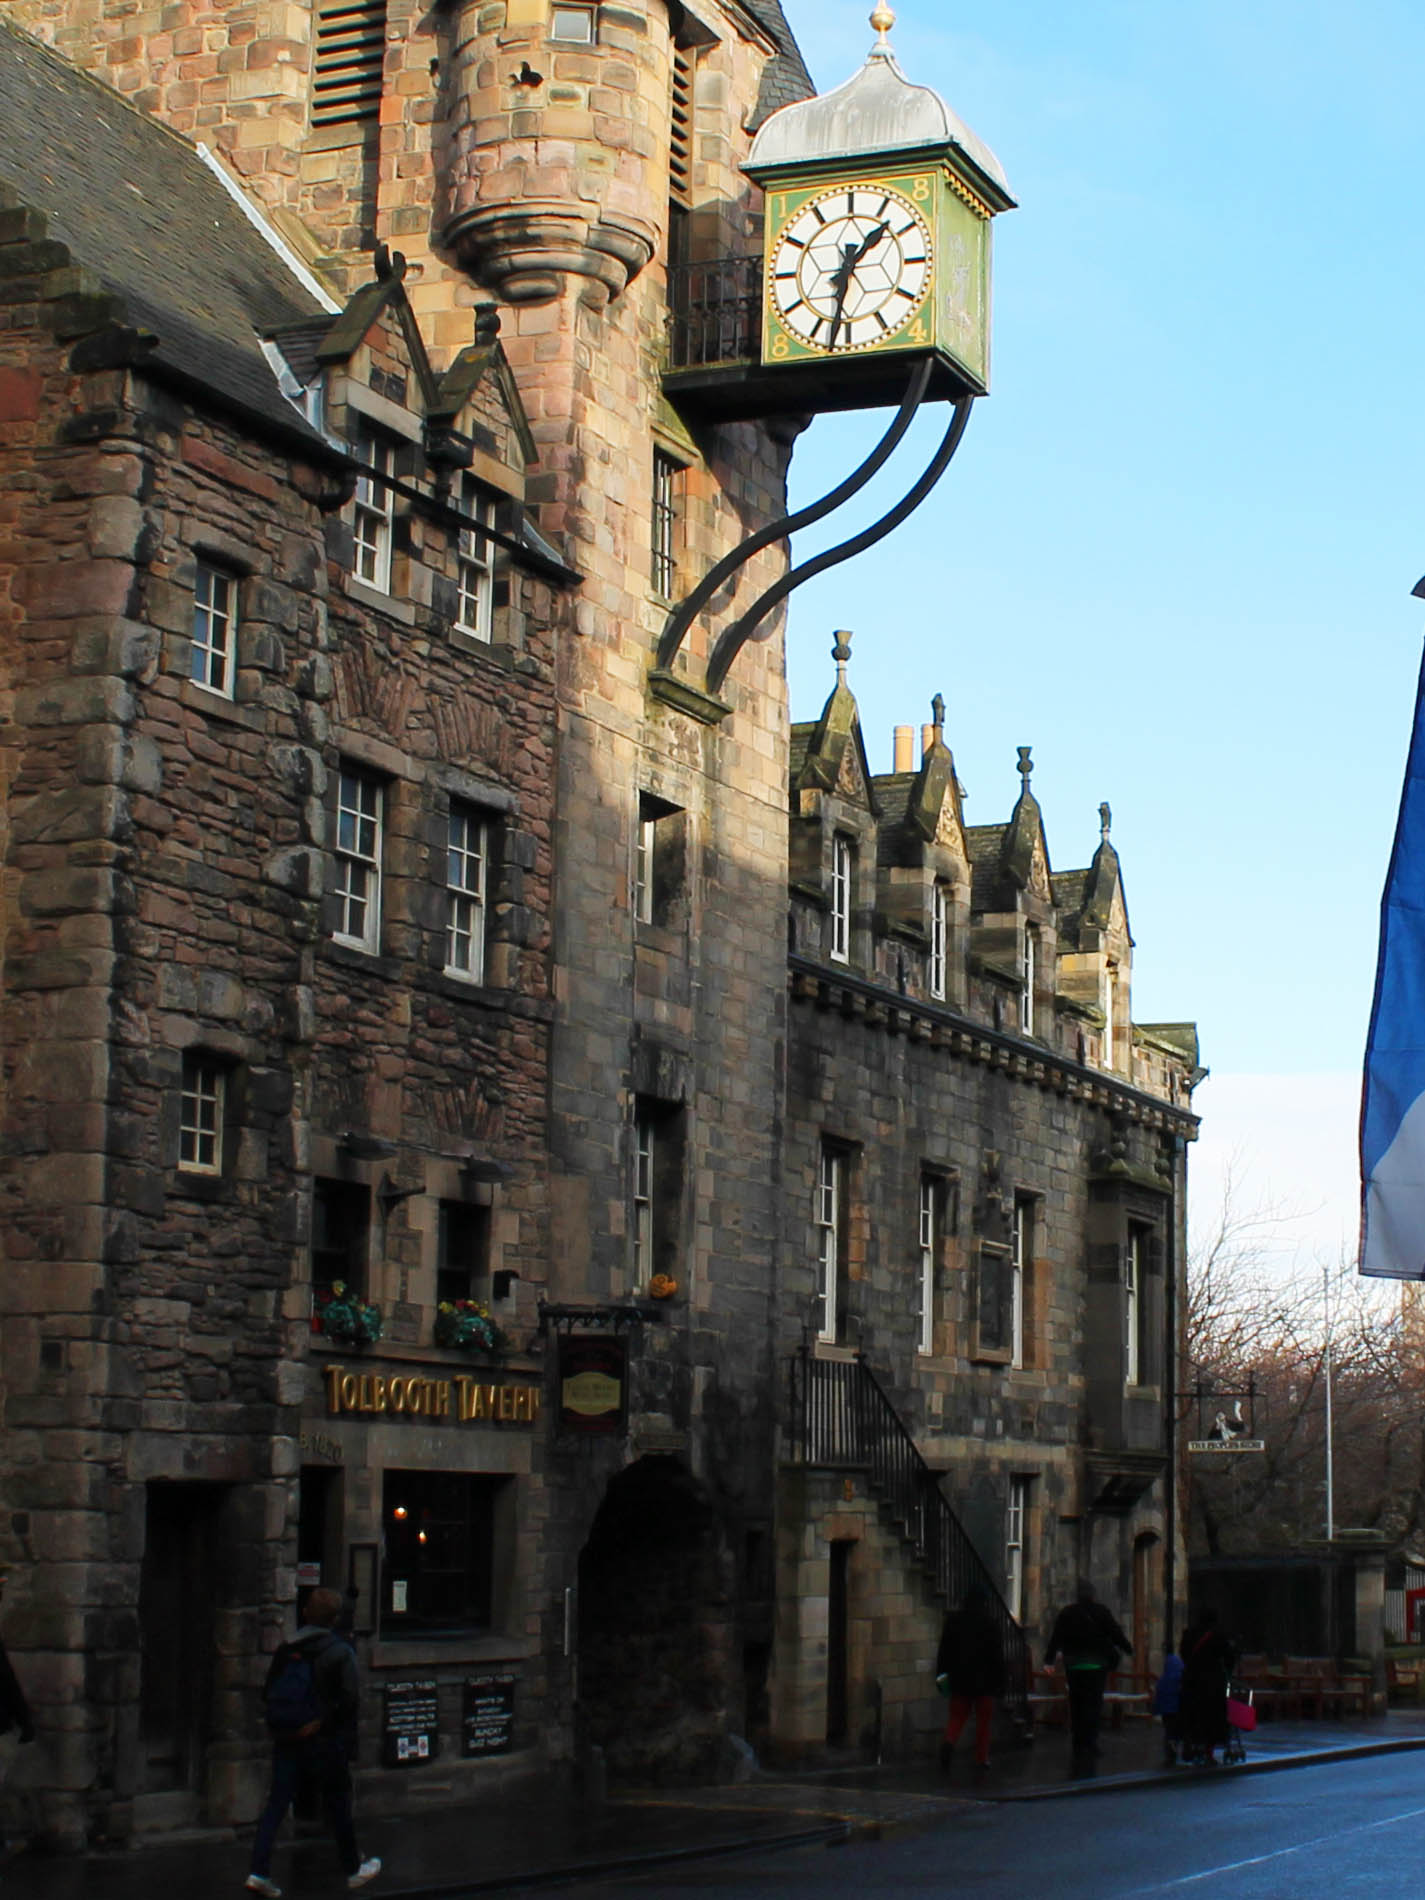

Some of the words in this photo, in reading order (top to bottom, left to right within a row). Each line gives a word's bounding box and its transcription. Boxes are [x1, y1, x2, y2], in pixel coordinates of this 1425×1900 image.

[777, 195, 788, 218] 1
[911, 177, 930, 201] 8
[771, 333, 790, 357] 8
[907, 318, 927, 343] 4
[324, 1363, 450, 1417] TOLBOOTH
